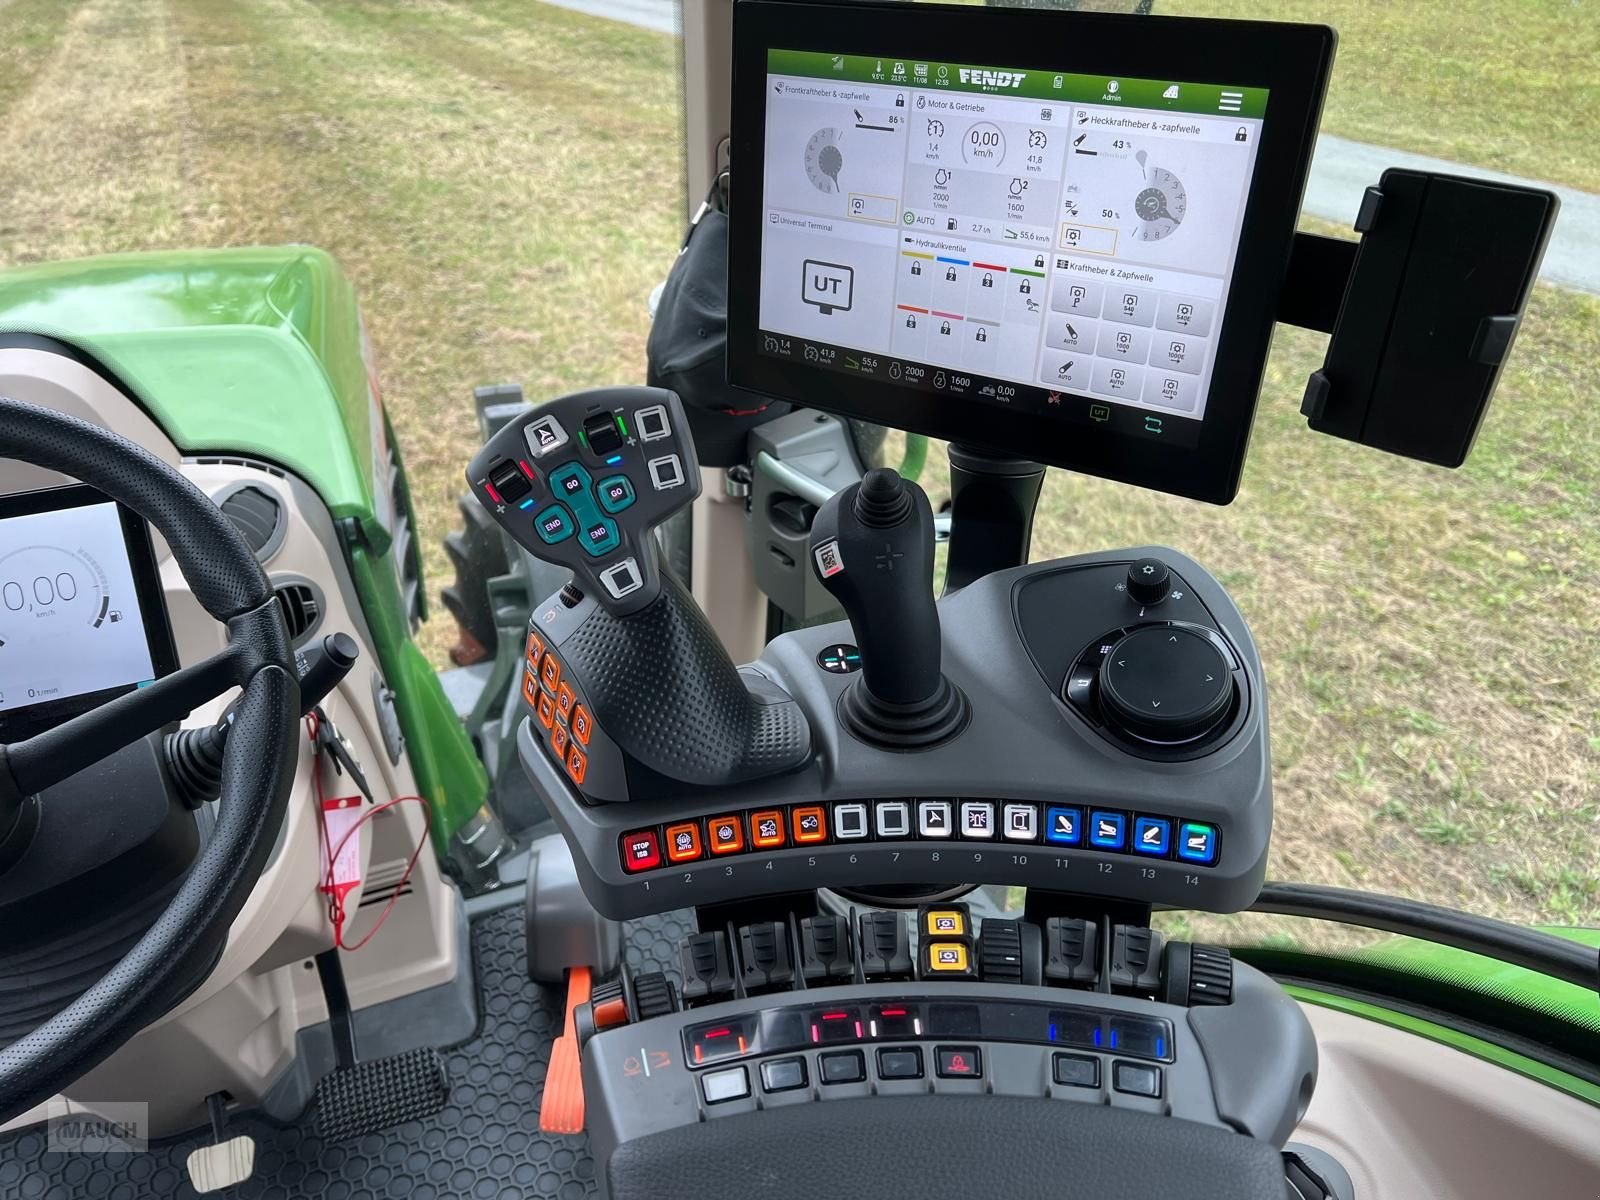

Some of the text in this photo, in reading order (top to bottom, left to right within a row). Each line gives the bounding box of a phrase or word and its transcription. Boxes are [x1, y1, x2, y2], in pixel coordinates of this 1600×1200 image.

[959, 68, 1026, 88] FENDT
[785, 86, 832, 98] Frontkraftheber
[928, 100, 985, 113] Motor & Getriebe
[888, 116, 898, 124] 86
[1090, 116, 1200, 135] Heckkraftheber & -zapfwelle
[971, 130, 999, 147] 0,00
[1112, 140, 1124, 149] 43
[974, 148, 994, 158] km/h
[1027, 155, 1043, 164] 41,8
[1026, 165, 1042, 173] km/h
[1022, 180, 1028, 190] 2
[932, 192, 950, 202] 2000
[1008, 202, 1024, 212] 1600
[1102, 209, 1113, 218] 50
[780, 217, 806, 228] Universal
[808, 221, 833, 232] Terminal
[916, 216, 935, 226] AUTO
[972, 224, 983, 232] 2,7
[1020, 231, 1034, 241] 55,6
[916, 239, 966, 254] Hydraulikventile
[1070, 262, 1154, 283] Kraftheber & Zapfwelle
[814, 275, 842, 294] UT
[1072, 298, 1080, 308] P
[862, 357, 878, 368] 55,6
[905, 366, 924, 377] 2000
[951, 376, 970, 387] 1600
[997, 385, 1015, 396] 0,00
[1162, 388, 1178, 396] AUTO
[566, 479, 579, 490] GO
[610, 488, 623, 498] GO
[544, 518, 561, 532] END
[590, 526, 606, 539] END
[2, 572, 77, 612] 0,00
[27, 688, 36, 698] 0
[632, 841, 650, 850] STOP
[808, 857, 816, 866] 5
[850, 854, 857, 864] 6
[892, 852, 900, 862] 7
[932, 852, 940, 862] 8
[974, 853, 982, 863] 9
[1012, 856, 1028, 865] 10
[766, 861, 773, 870] 4
[1055, 858, 1069, 868] 11
[725, 866, 733, 876] 3
[1098, 863, 1113, 874] 12
[1141, 868, 1156, 879] 13
[684, 874, 692, 883] 2
[1184, 875, 1199, 886] 14
[644, 882, 650, 890] 1
